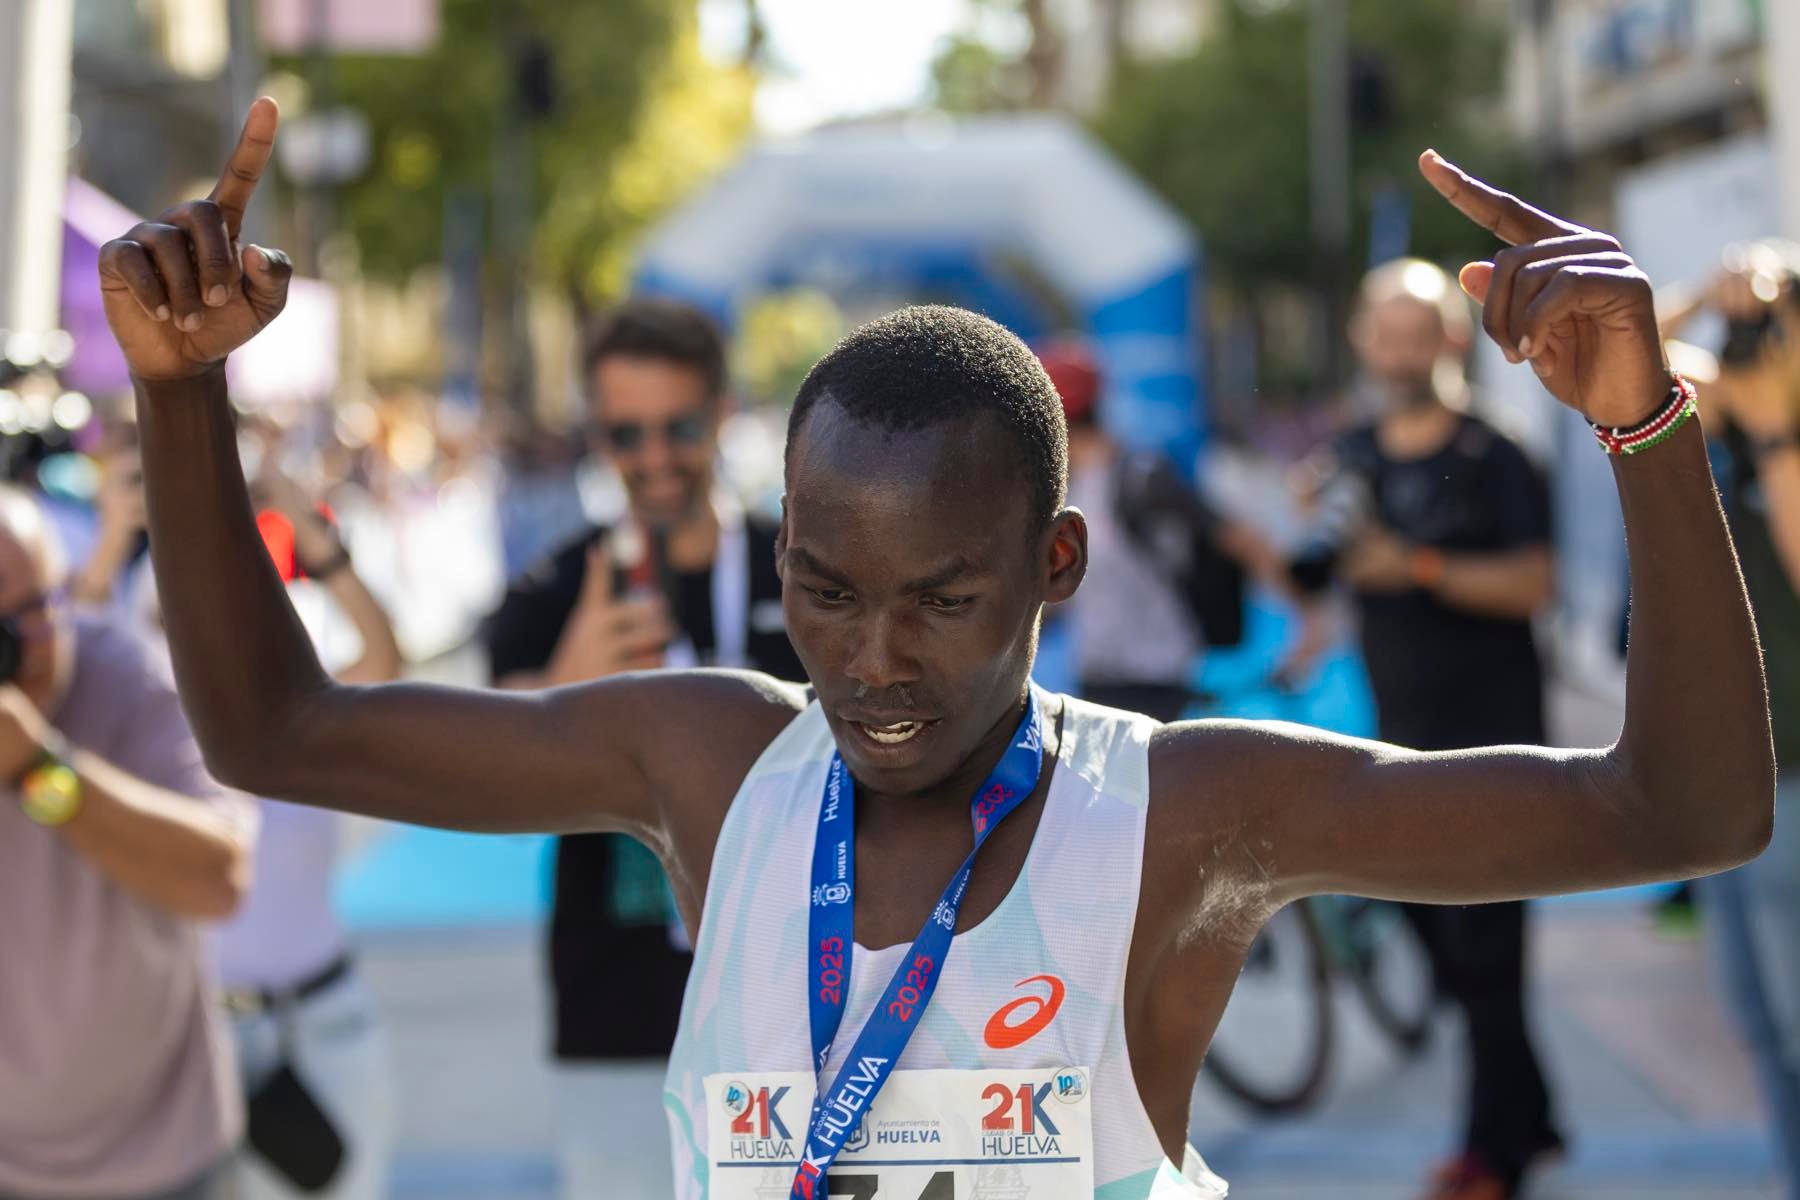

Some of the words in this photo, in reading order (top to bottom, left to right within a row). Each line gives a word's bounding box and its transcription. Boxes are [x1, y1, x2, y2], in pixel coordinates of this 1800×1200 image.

[823, 758, 841, 822] Huelva
[837, 840, 846, 879] HUELVA
[820, 936, 843, 1005] 2025
[889, 955, 935, 1022] 2025
[817, 1056, 889, 1148] HUELVA
[981, 1082, 1061, 1135] 21K
[730, 1140, 795, 1159] HUELVA
[877, 1130, 941, 1144] HUELVA
[982, 1136, 1061, 1156] HUELVA
